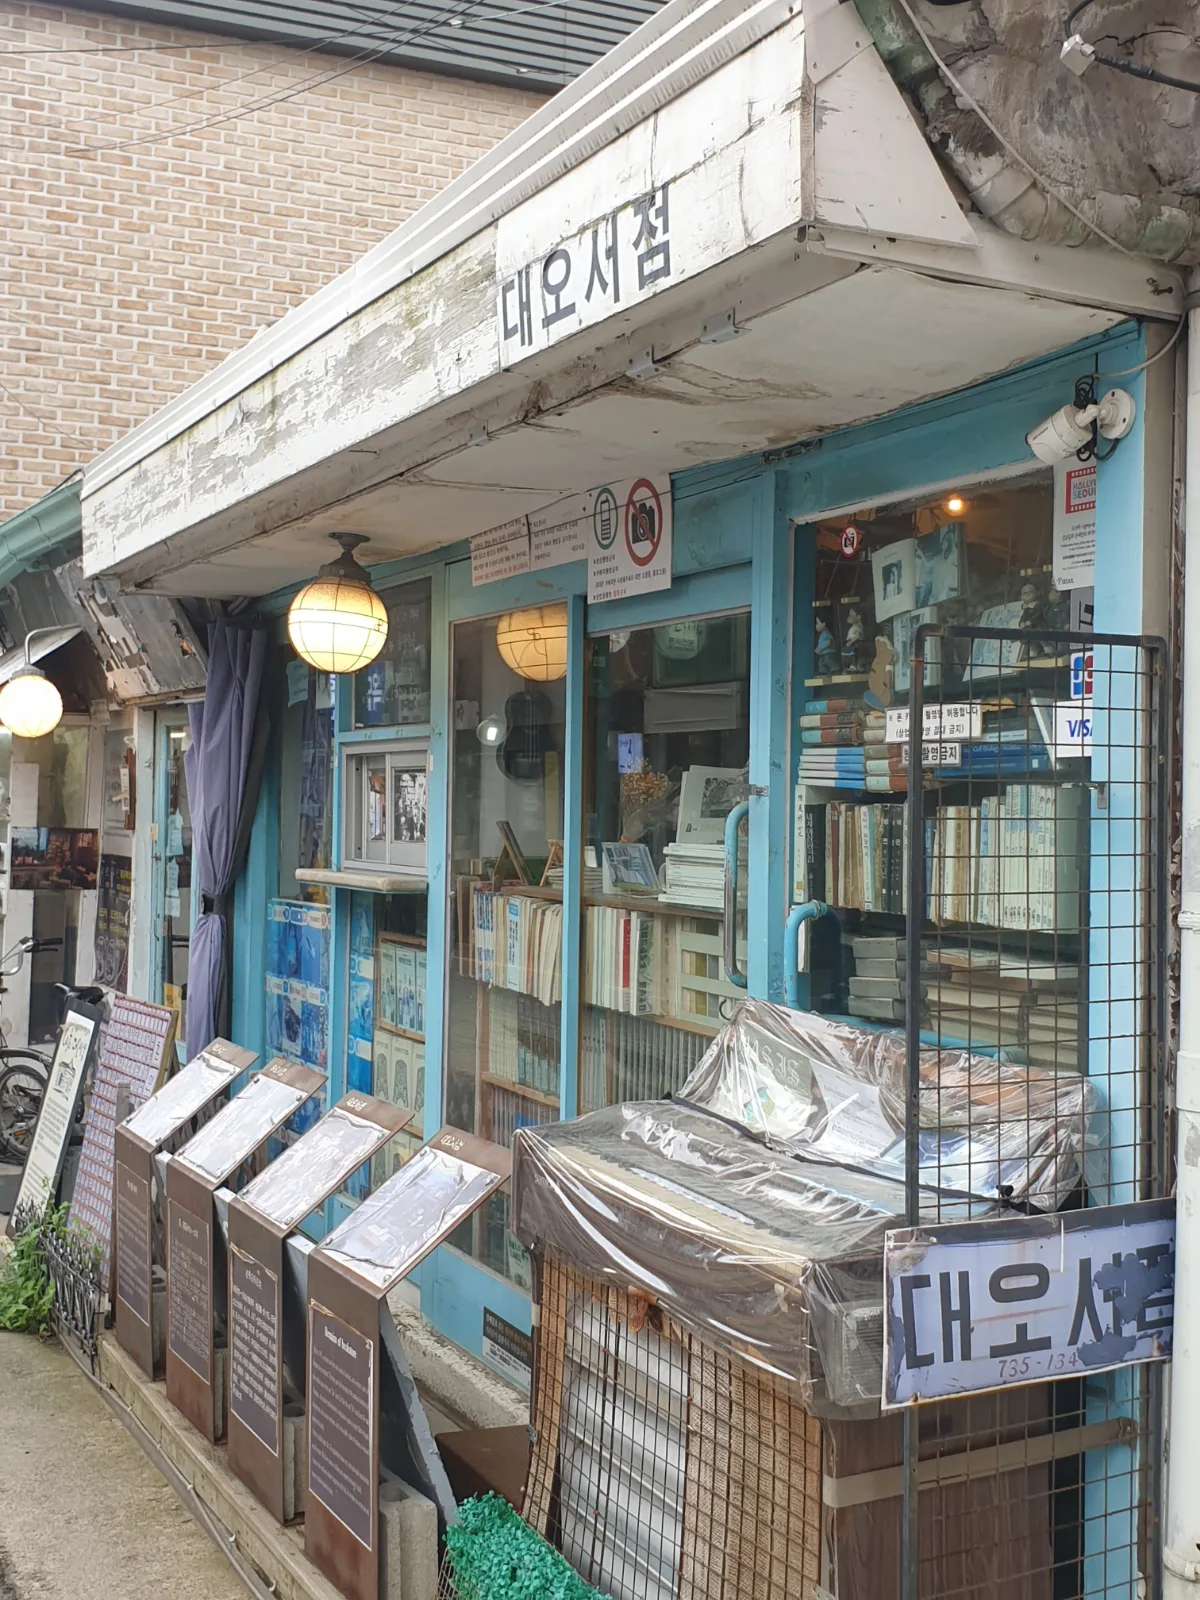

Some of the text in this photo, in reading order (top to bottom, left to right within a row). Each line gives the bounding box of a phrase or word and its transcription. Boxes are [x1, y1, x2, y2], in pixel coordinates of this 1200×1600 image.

[501, 184, 671, 347] 대오서점
[946, 706, 979, 718] 허용합니다
[1066, 719, 1093, 738] VIS
[998, 1351, 1079, 1379] 735-134
